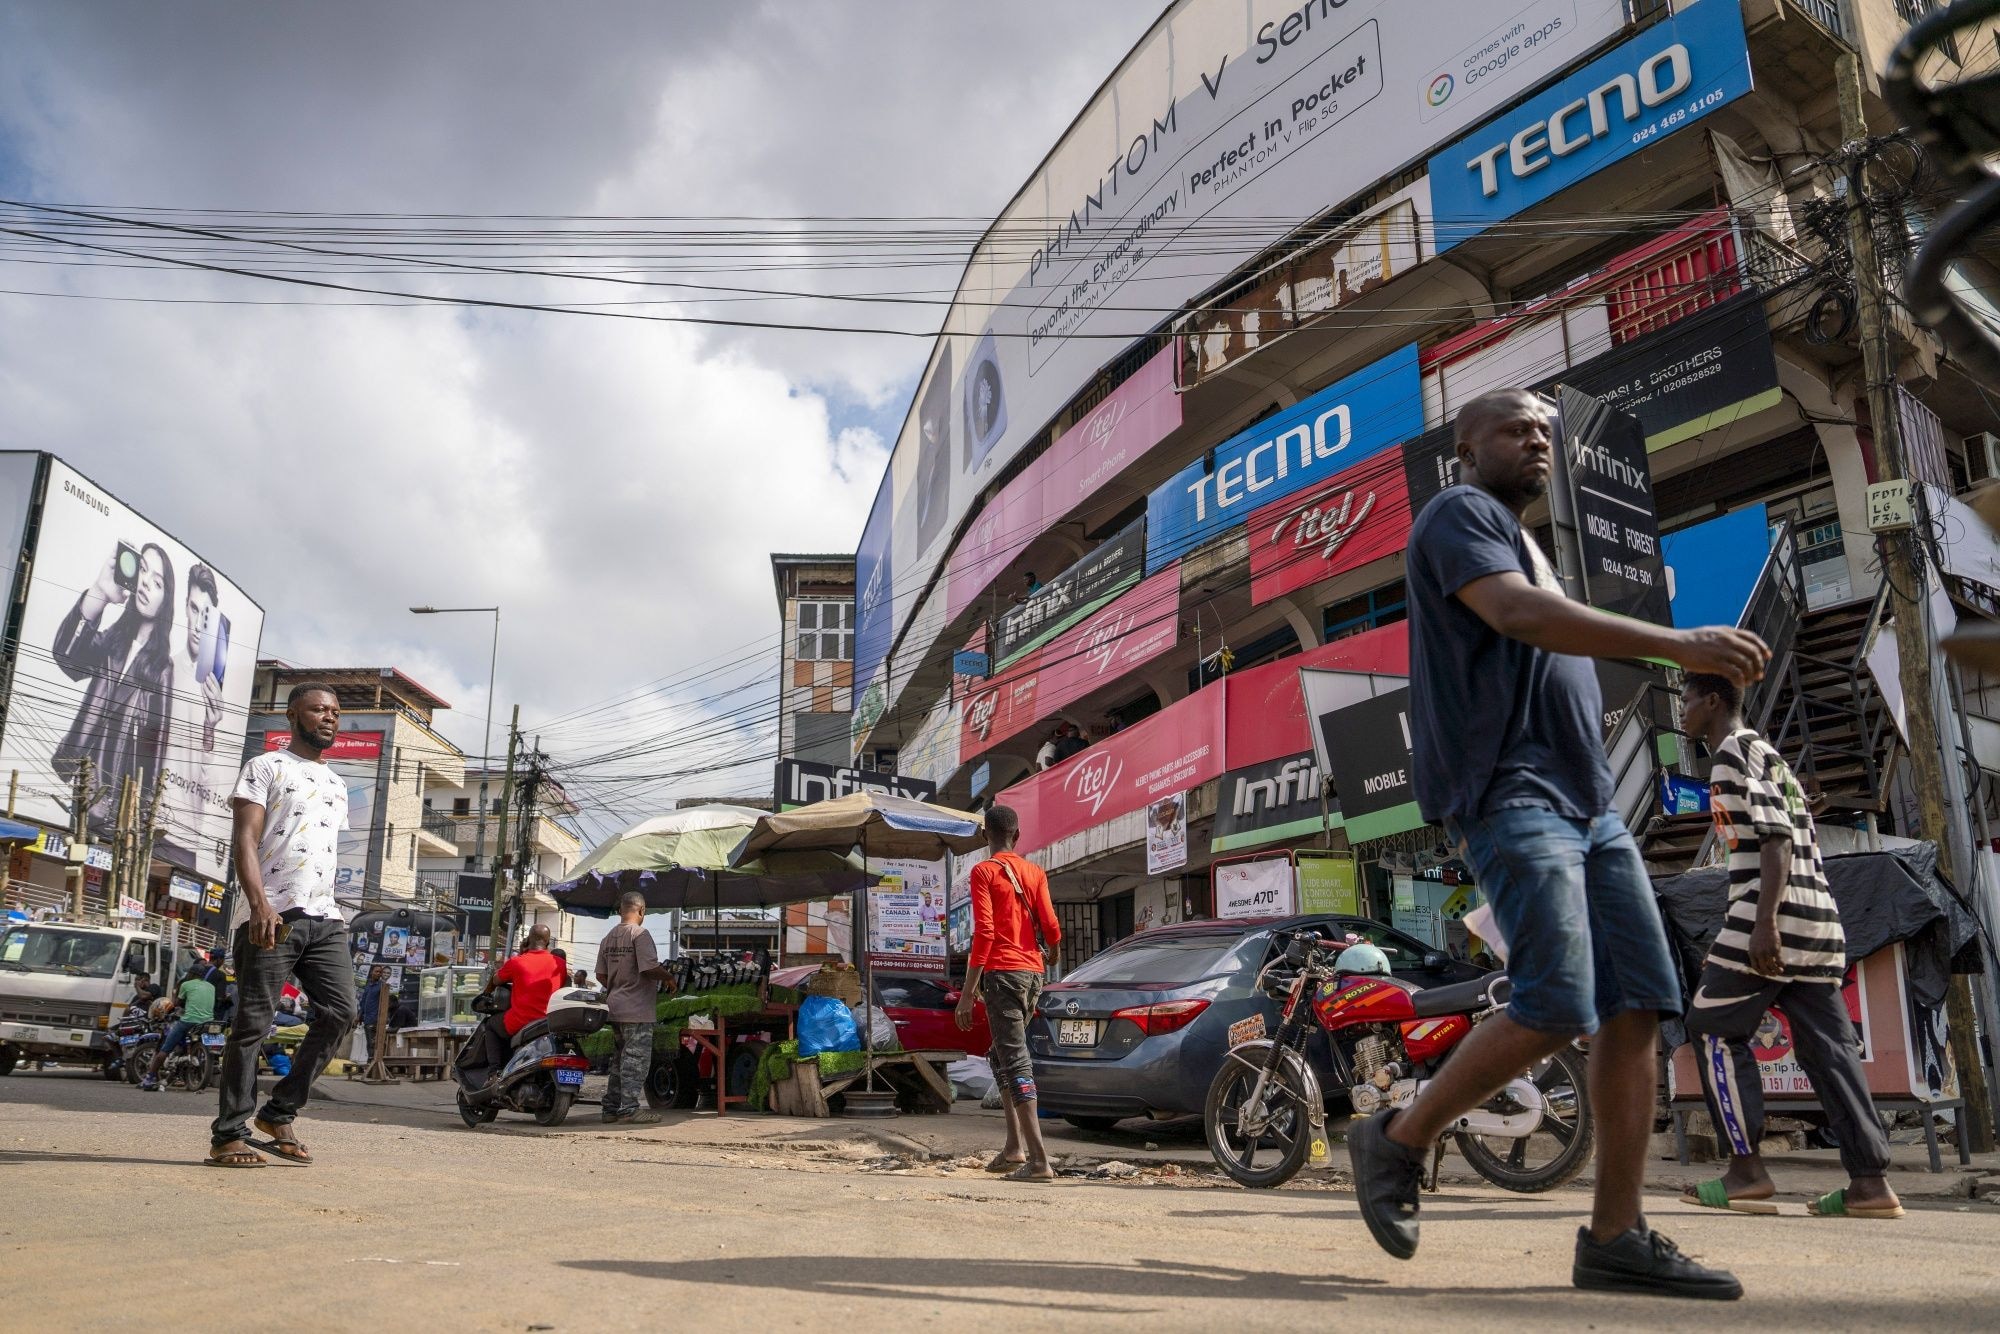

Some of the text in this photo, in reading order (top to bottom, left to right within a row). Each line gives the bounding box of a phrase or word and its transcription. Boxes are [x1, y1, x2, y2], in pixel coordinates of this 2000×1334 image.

[1463, 22, 1526, 69] comes with
[1464, 16, 1563, 86] Google apps
[1190, 55, 1366, 194] Perfect in Pocket
[1466, 43, 1693, 198] TECNO
[1632, 88, 1724, 144] 024 462 4105
[1213, 100, 1338, 194] PHANTOM V Flip 5G
[1030, 96, 1177, 287] PHANTOM
[1201, 54, 1228, 100] V
[1032, 190, 1178, 347] Beyond the Extraordinary
[1057, 293, 1099, 340] PHANTOM
[1112, 263, 1129, 283] Fold
[1635, 380, 1644, 391] &
[1663, 363, 1722, 393] 0208528529
[1079, 448, 1126, 492] Smart Phone
[1187, 404, 1352, 522] TECNO
[1575, 435, 1648, 494] Infinix
[64, 480, 110, 517] SAMSUNG
[1587, 513, 1655, 556] MOBILE FOREST
[1602, 557, 1622, 577] 0244
[1625, 565, 1638, 582] 232
[1005, 579, 1073, 646] Infinix
[1233, 756, 1319, 817] Infi
[1364, 769, 1408, 795] MOBILE
[1679, 799, 1699, 810] SUPER
[459, 896, 493, 907] Infinix
[1228, 890, 1274, 908] AWESOME A70
[1344, 982, 1378, 1001] ROYAL
[1060, 1032, 1090, 1044] 501-23
[1072, 1021, 1083, 1032] ER
[1769, 1077, 1783, 1090] 151
[1793, 1077, 1810, 1091] 024
[1774, 1063, 1788, 1074] Tip
